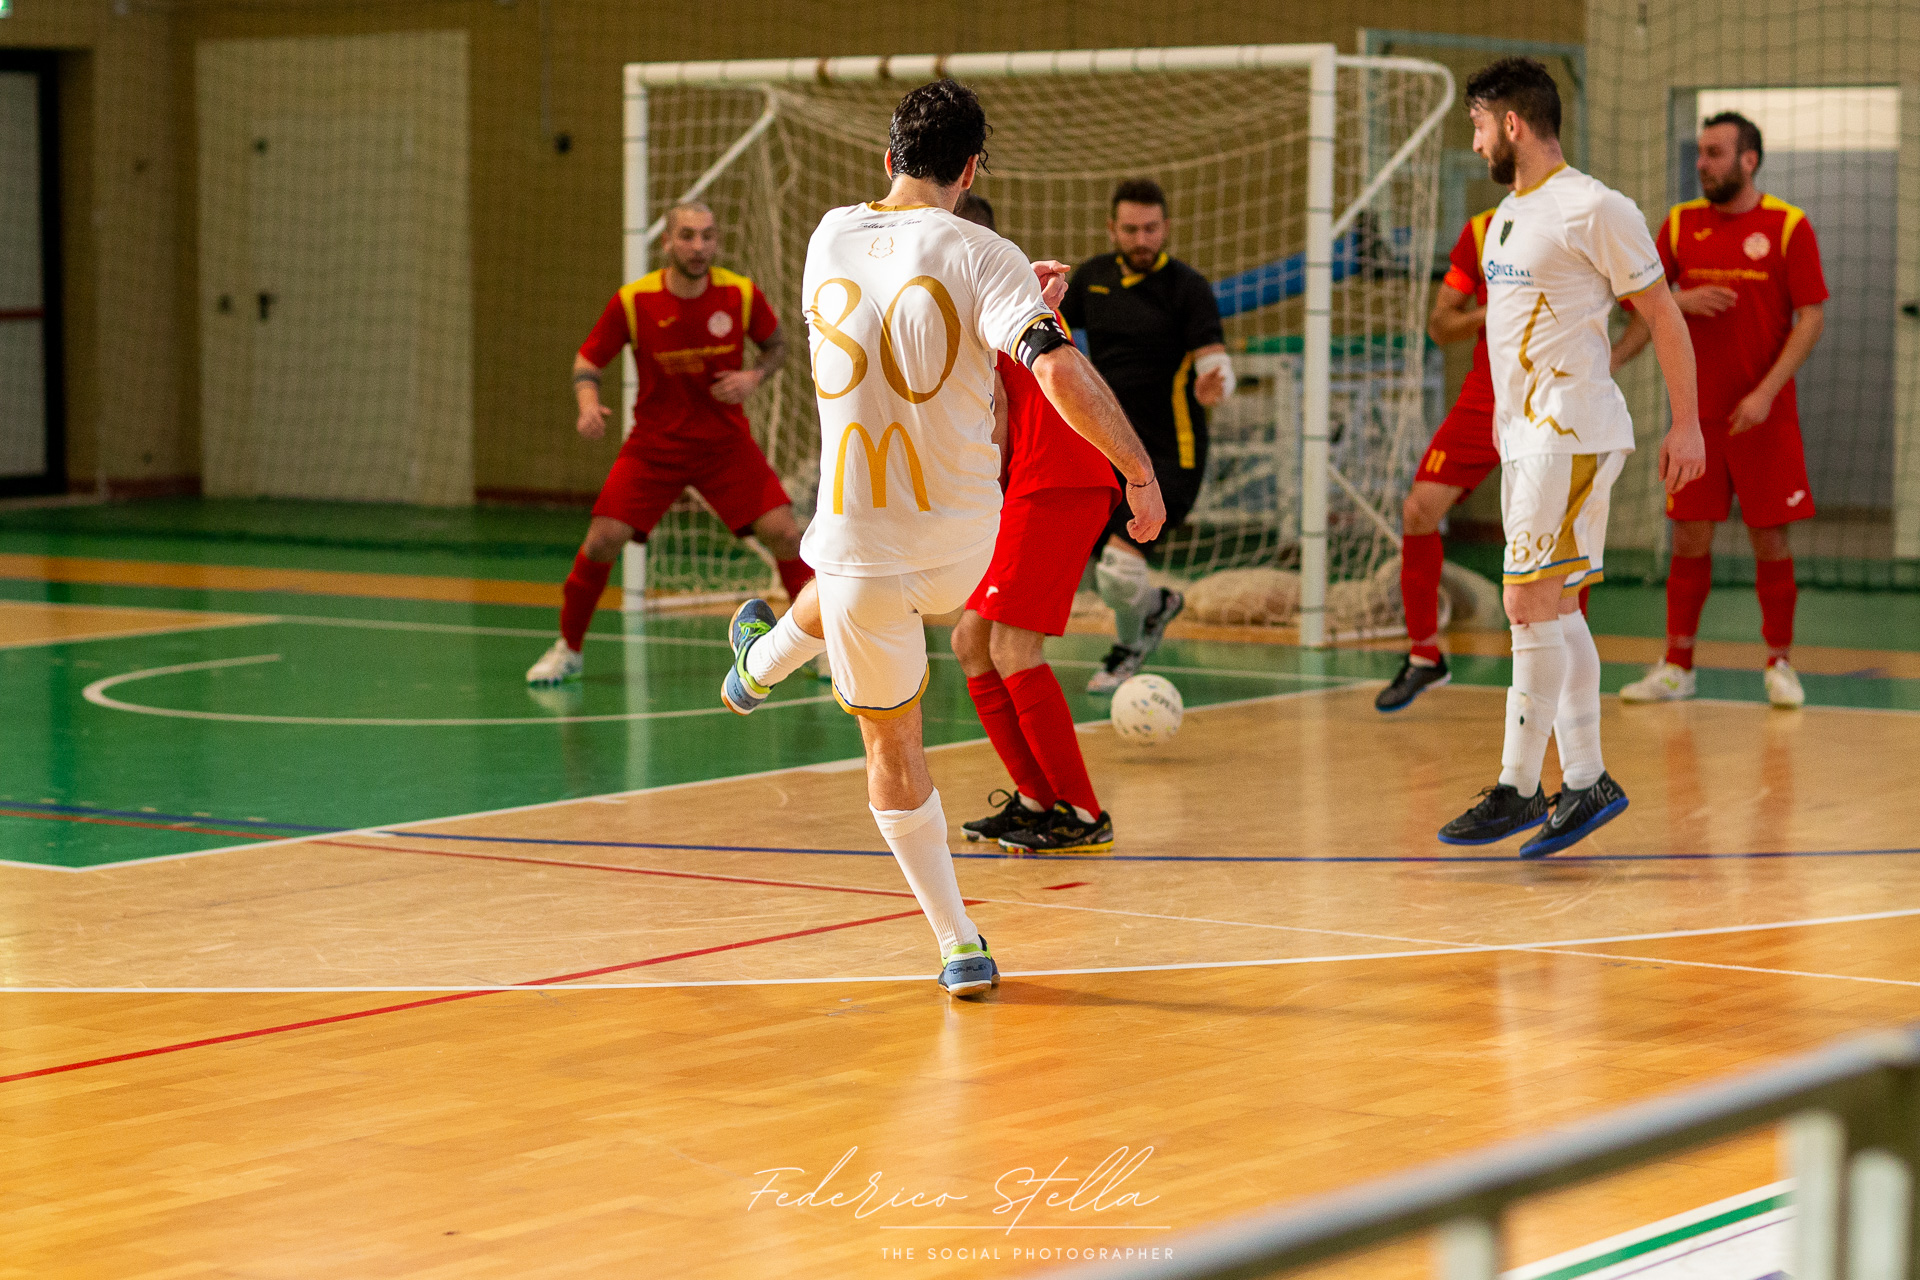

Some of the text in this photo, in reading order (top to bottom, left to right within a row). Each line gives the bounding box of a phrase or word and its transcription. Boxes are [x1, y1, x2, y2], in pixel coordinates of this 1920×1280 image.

[810, 274, 961, 404] 80
[1425, 448, 1447, 474] 11
[1511, 530, 1556, 565] 69
